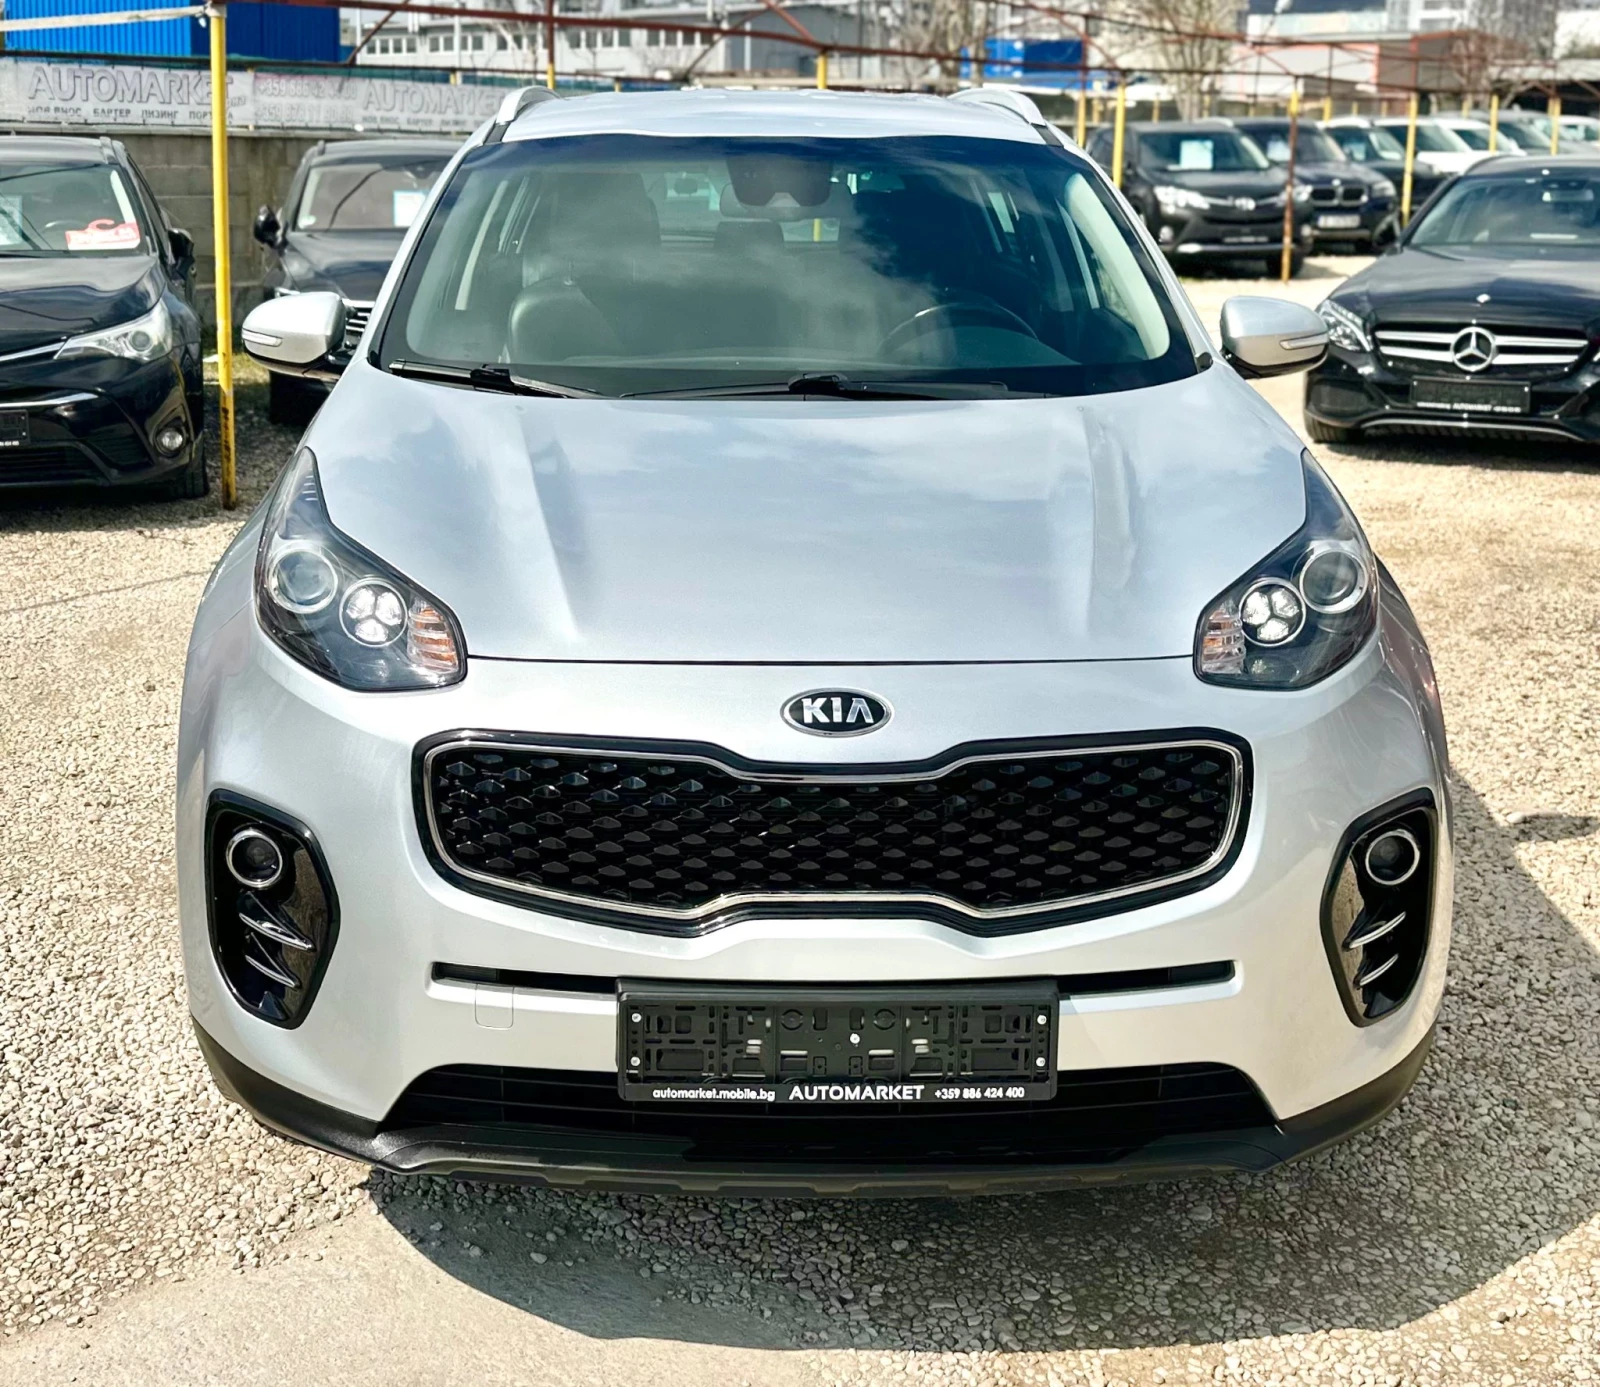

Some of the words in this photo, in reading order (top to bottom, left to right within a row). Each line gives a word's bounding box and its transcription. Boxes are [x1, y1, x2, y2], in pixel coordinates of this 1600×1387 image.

[801, 697, 874, 724] KIA
[652, 1087, 776, 1102] automarket.mobile.bg
[788, 1085, 925, 1101] AUTOMARKET
[934, 1087, 961, 1100] +359
[962, 1087, 982, 1099] 886
[983, 1087, 1004, 1099] 424
[1005, 1086, 1026, 1099] 400
